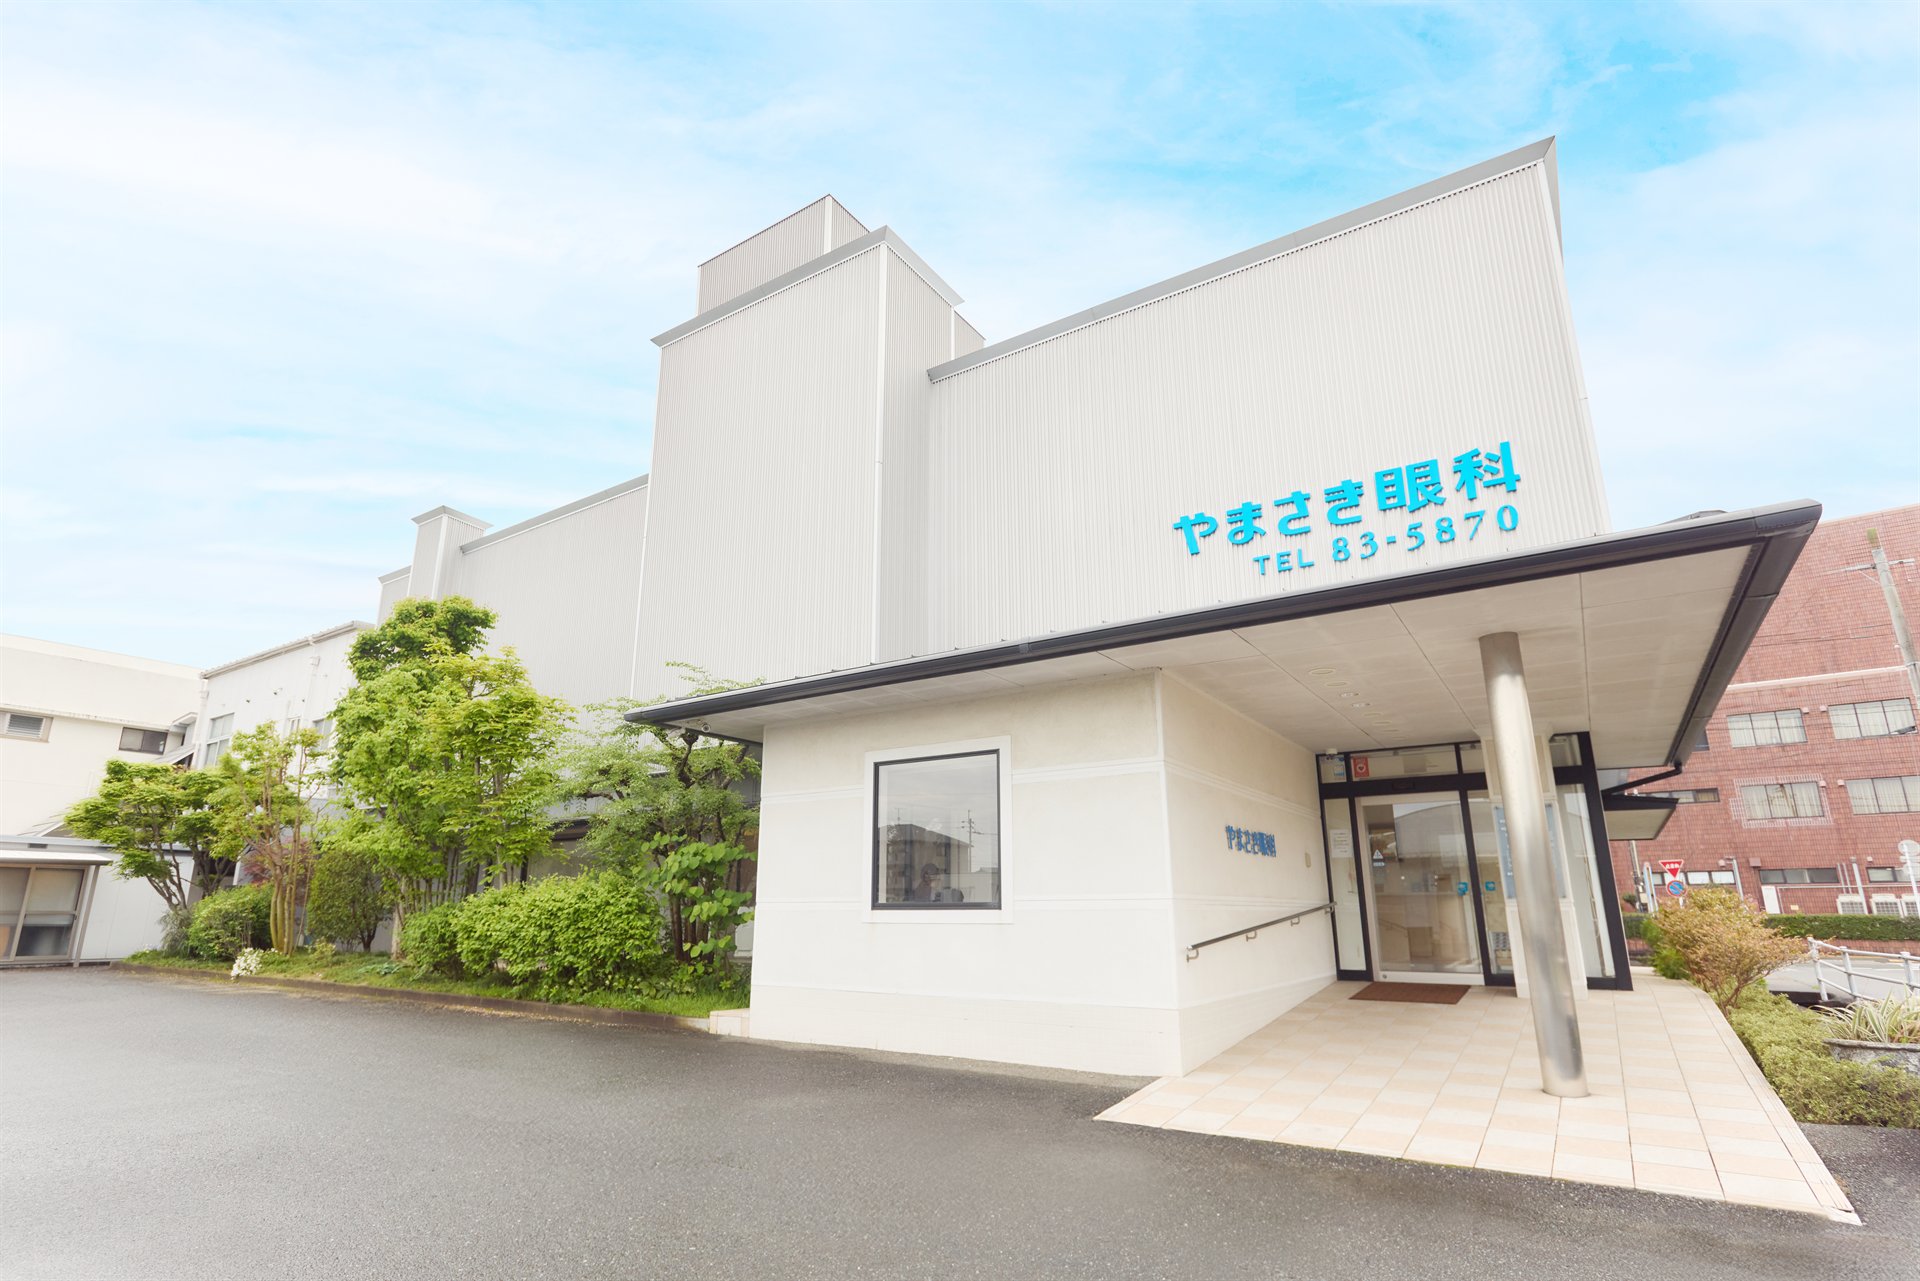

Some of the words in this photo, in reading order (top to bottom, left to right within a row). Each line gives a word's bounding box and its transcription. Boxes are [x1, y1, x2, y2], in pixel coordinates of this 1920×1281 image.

[1173, 441, 1521, 556] やまさき眼科
[1253, 548, 1314, 575] TEL
[1332, 504, 1519, 561] 83-5870
